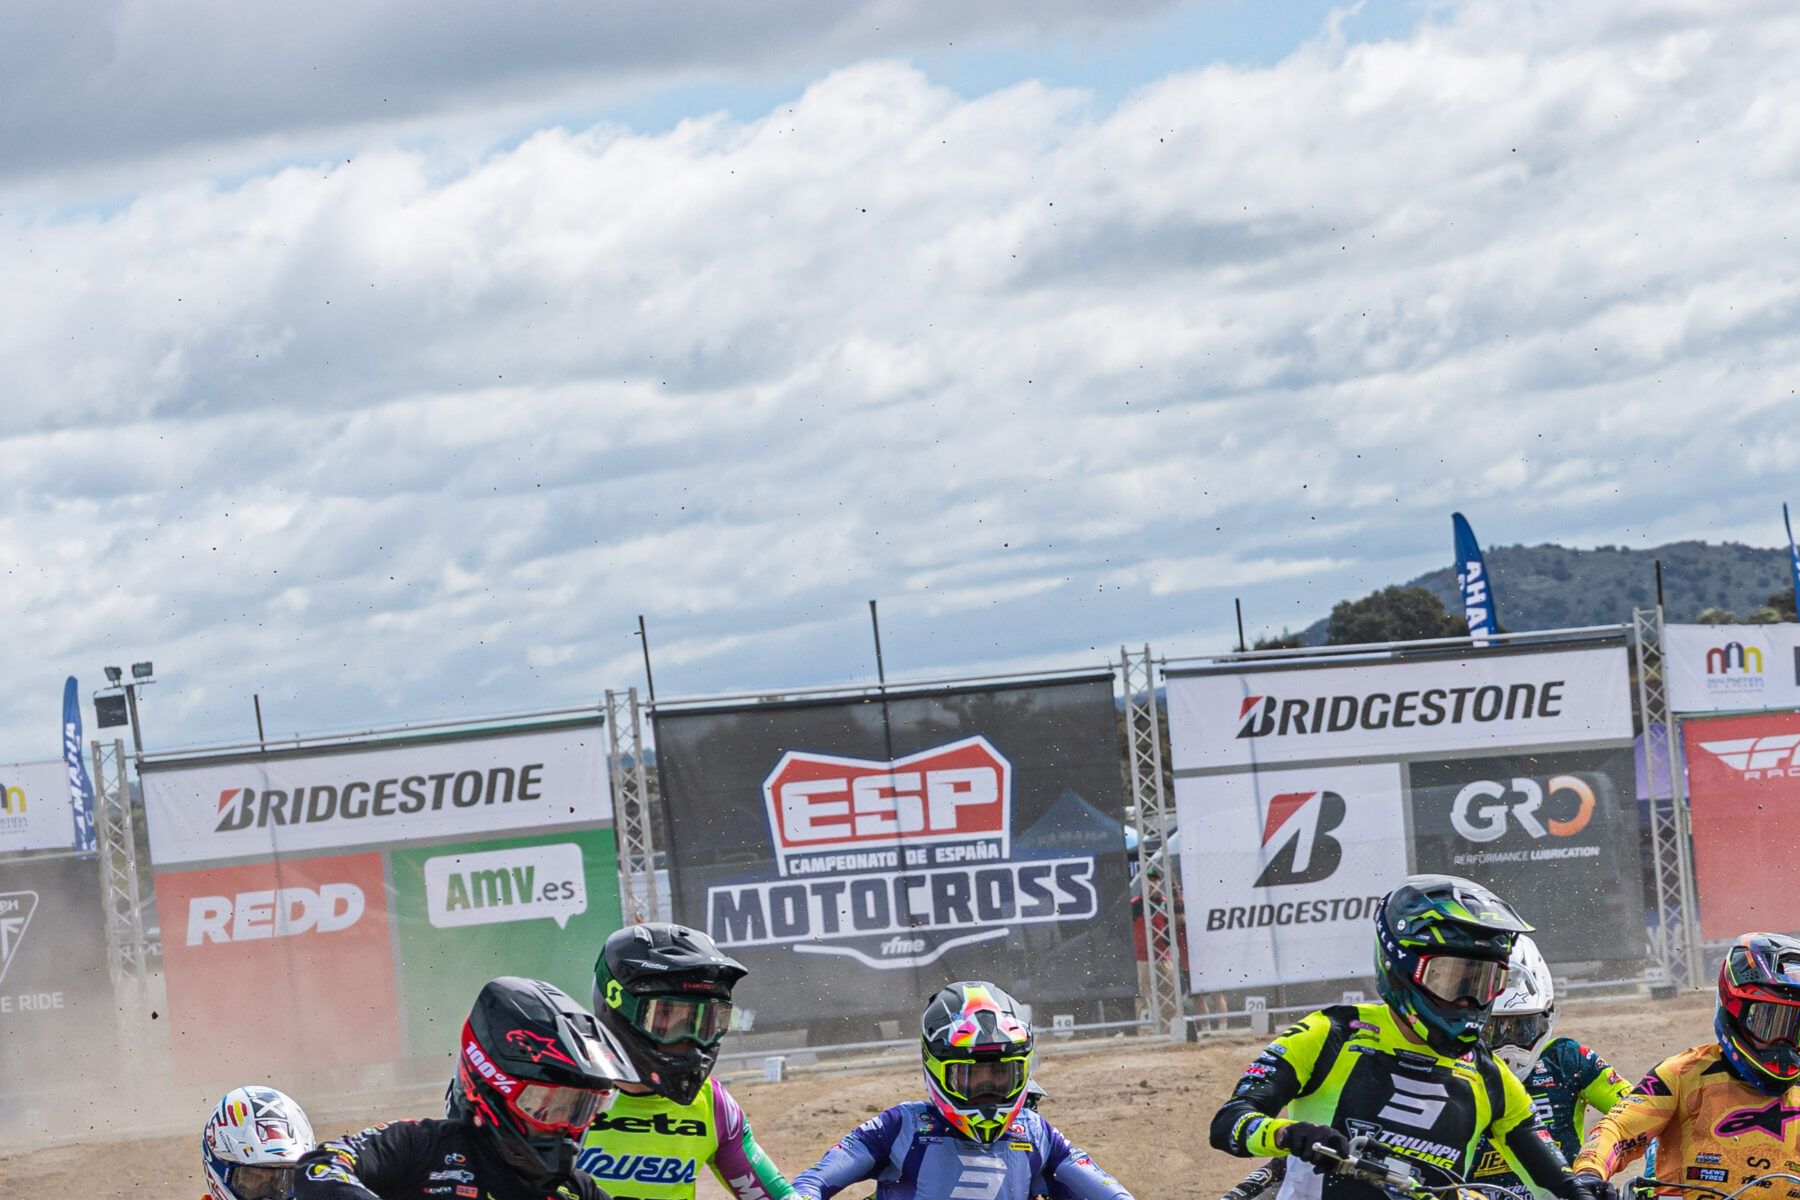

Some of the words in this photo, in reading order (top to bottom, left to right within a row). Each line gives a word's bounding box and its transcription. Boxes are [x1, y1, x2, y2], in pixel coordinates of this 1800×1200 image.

[1236, 681, 1565, 738] BRIDGESTONE
[214, 762, 545, 833] BRIDGESTONE
[780, 766, 999, 842] ESP
[789, 850, 897, 876] CAMPEONATO
[906, 848, 927, 867] DE
[935, 840, 1000, 863] ESPAÑA
[1454, 849, 1529, 866] PERFORMANCE
[1530, 845, 1600, 861] LUBRICATION
[446, 864, 575, 913] Amv.es
[711, 861, 1095, 943] MOTOCROSS
[186, 883, 365, 947] REDD
[1206, 896, 1380, 932] BRIDGESTON
[880, 935, 926, 957] rfme
[20, 993, 64, 1013] RIDE
[464, 1040, 513, 1094] 100%
[1379, 1130, 1461, 1161] TRIUMPH
